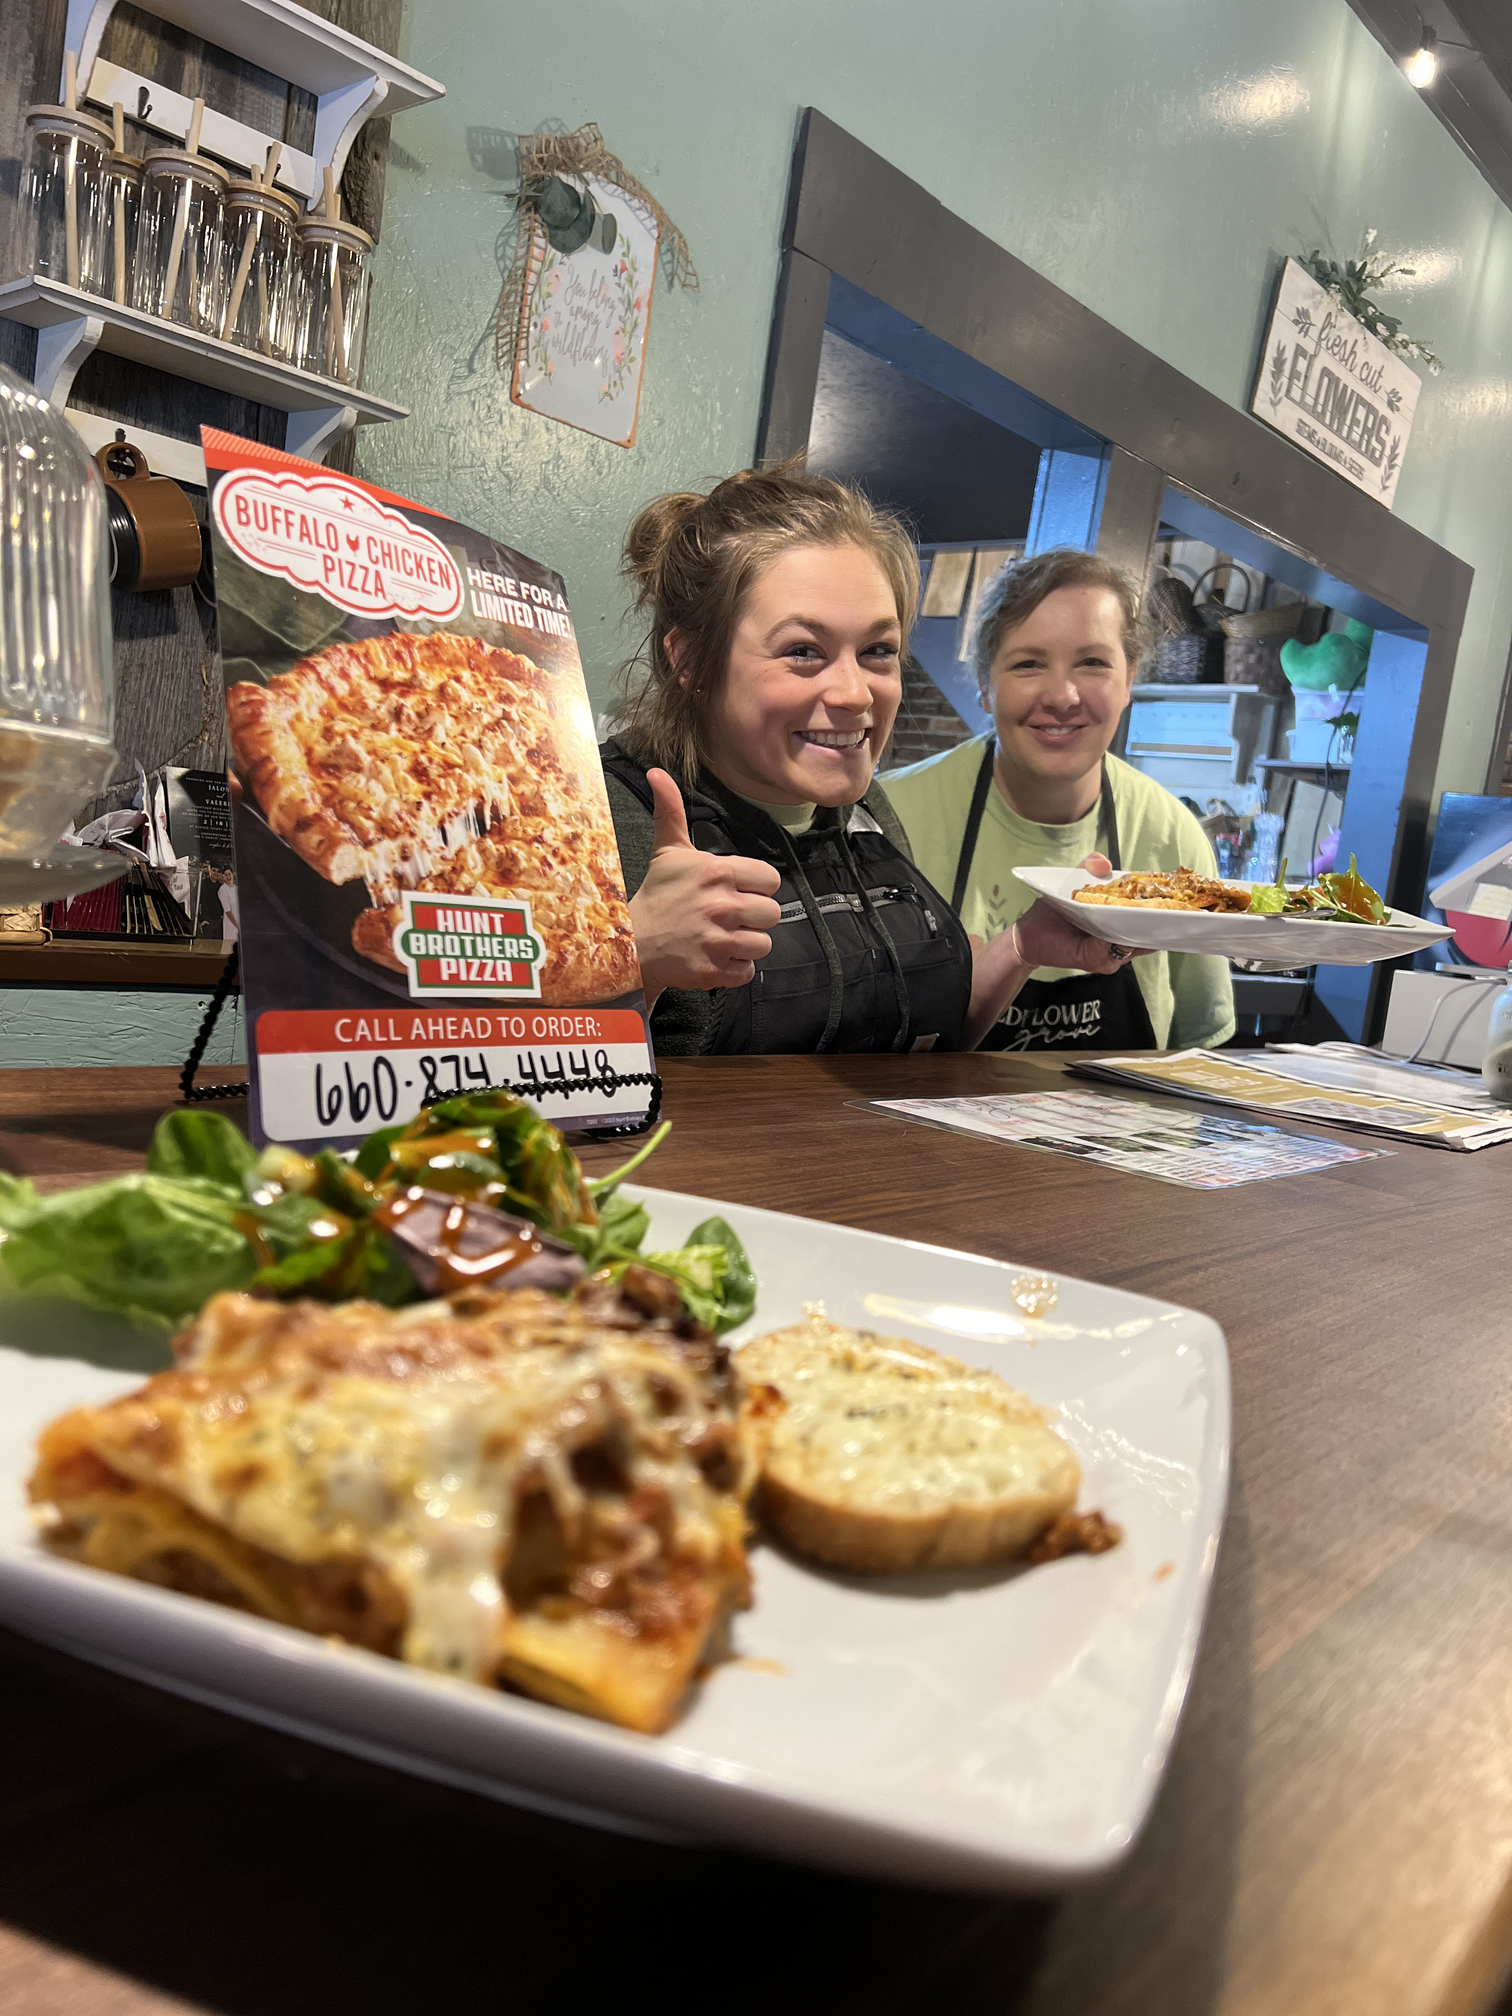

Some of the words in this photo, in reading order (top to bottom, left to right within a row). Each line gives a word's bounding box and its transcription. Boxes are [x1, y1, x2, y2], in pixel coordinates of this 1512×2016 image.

[587, 268, 618, 329] belong
[1313, 312, 1358, 375] fresh
[1359, 361, 1385, 395] cut
[1285, 342, 1393, 468] FLOWERS
[235, 494, 340, 553] BUFFALO
[366, 536, 452, 591] CHICKEN
[322, 553, 387, 600] PIZZA
[466, 566, 518, 598] HERE
[519, 581, 554, 608] FOR
[556, 593, 571, 613] A
[469, 589, 534, 629] LIMITED
[533, 605, 572, 639] TIME!
[435, 909, 504, 935] HUNT
[408, 932, 534, 960] BROTHERS
[439, 957, 513, 982] PIZZA
[333, 1018, 403, 1043] CALL
[410, 1017, 493, 1041] AHEAD
[495, 1016, 526, 1039] TO
[531, 1015, 602, 1038] ORDER:
